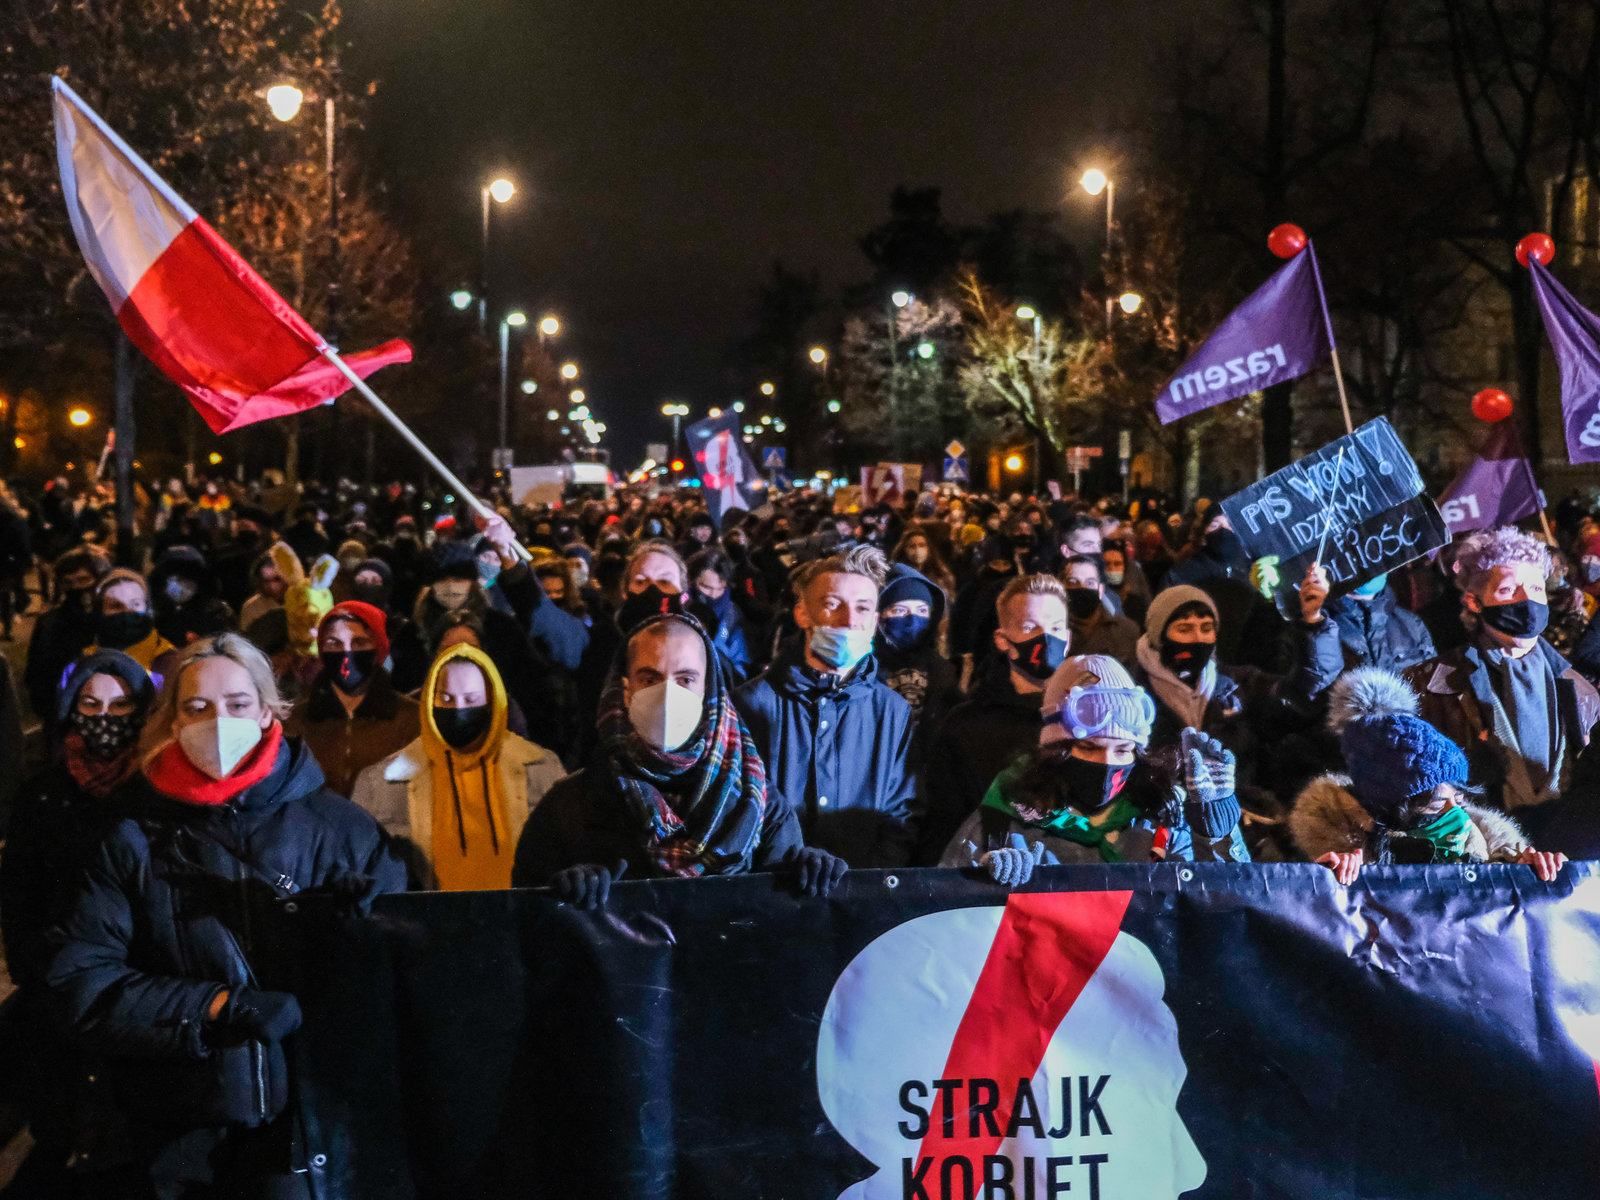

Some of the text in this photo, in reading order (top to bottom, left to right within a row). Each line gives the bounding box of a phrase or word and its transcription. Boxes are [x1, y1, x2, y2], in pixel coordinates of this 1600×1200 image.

[1240, 486, 1292, 535] PIS
[898, 1074, 1113, 1140] STRAJK
[902, 1153, 1109, 1200] KOBIET
